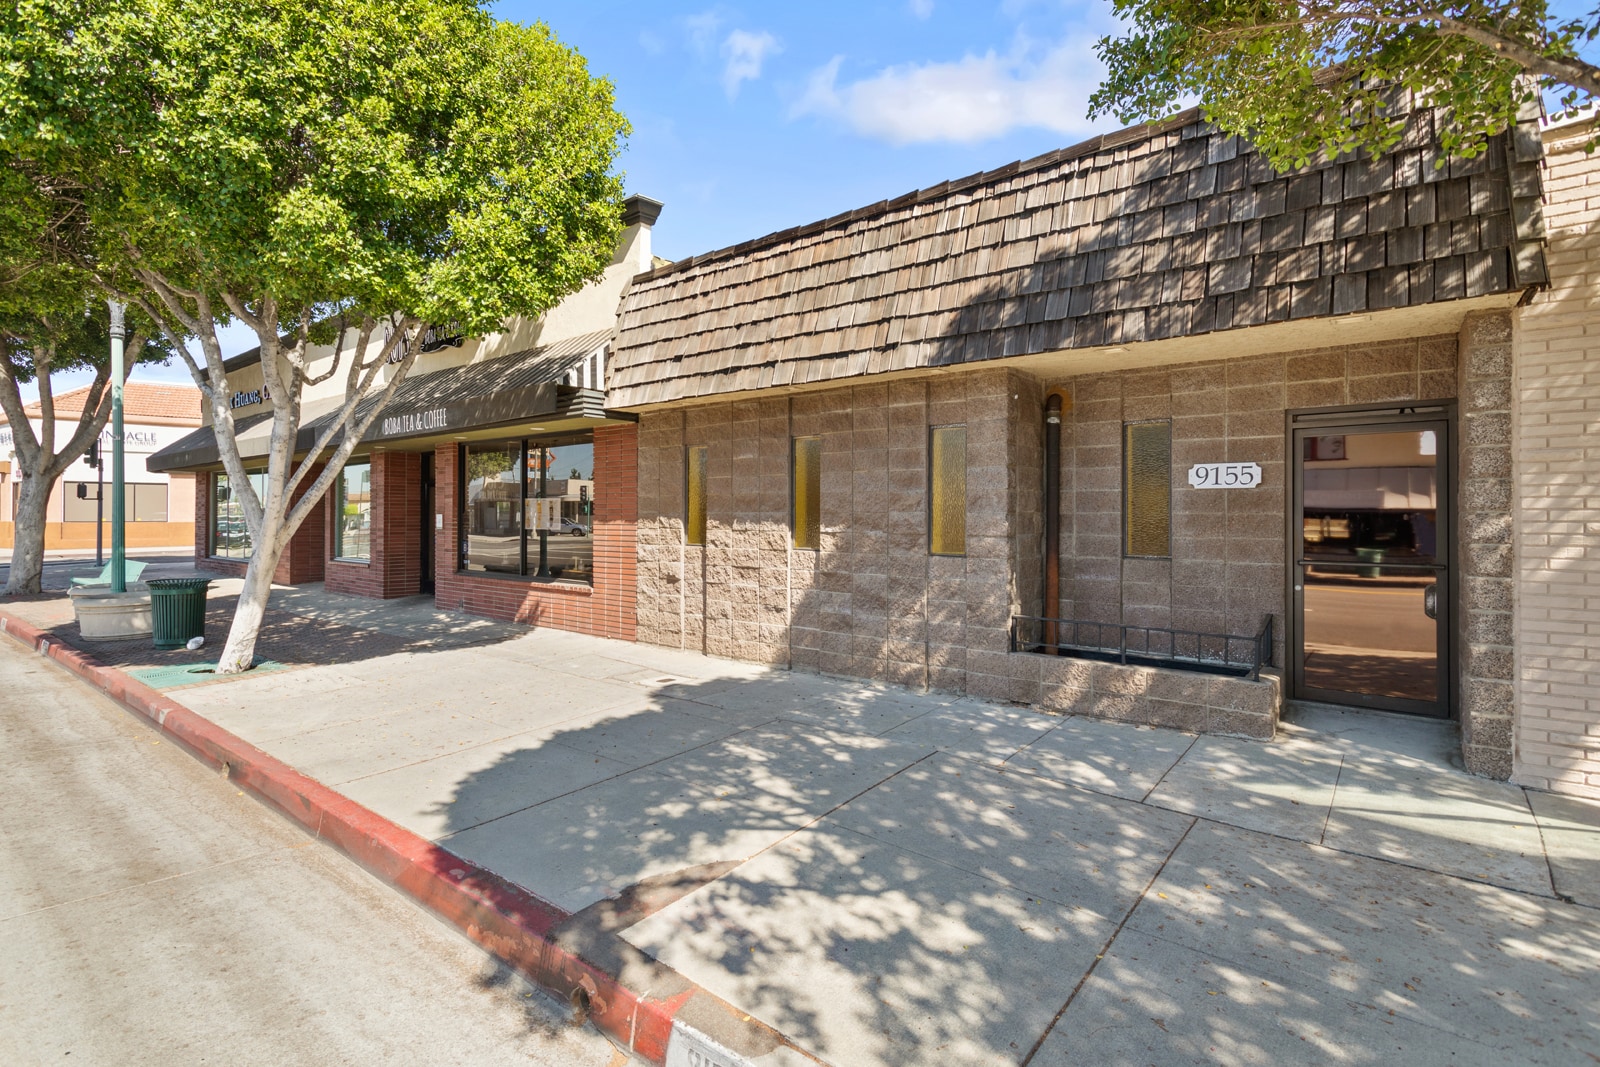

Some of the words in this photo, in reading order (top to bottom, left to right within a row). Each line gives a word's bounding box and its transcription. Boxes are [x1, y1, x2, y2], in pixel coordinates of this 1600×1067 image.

[384, 416, 401, 435] BOBA
[402, 414, 414, 433] TEA
[415, 412, 423, 430] &
[423, 407, 448, 430] COFFEE
[101, 430, 157, 442] INACLE
[1195, 465, 1254, 486] 9155
